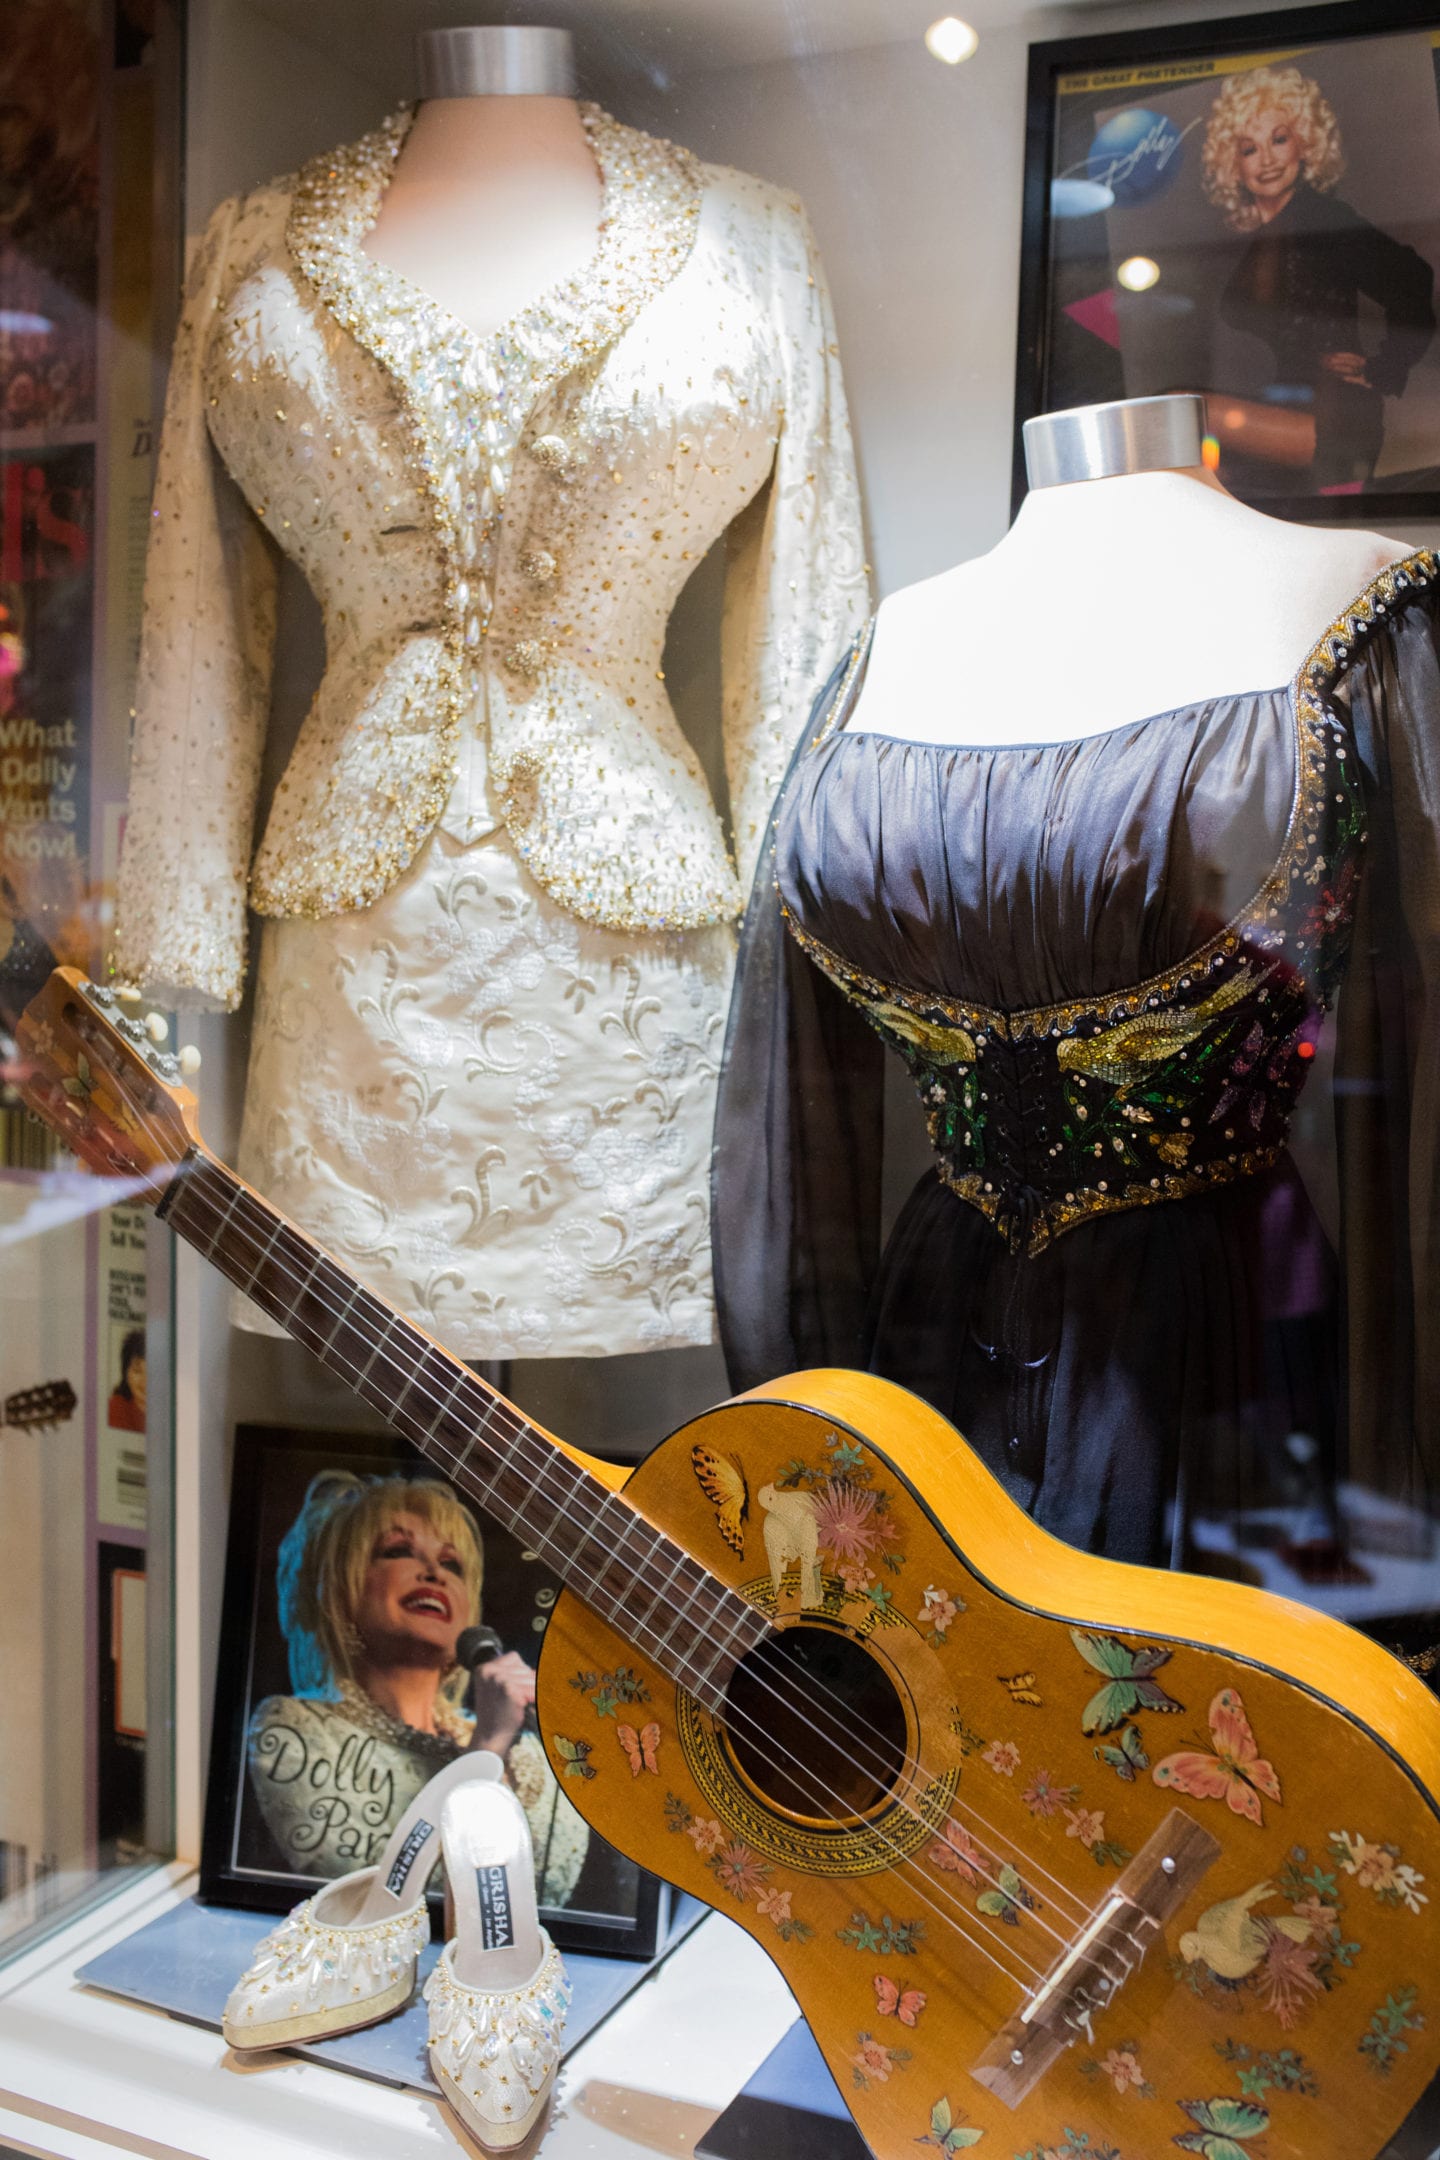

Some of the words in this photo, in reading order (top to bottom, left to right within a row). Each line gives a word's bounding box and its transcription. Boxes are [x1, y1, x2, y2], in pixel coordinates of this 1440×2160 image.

[1065, 78, 1088, 89] THE
[1092, 73, 1132, 86] GREAT
[1136, 61, 1215, 81] PRETENDER
[0, 718, 77, 748] What
[2, 755, 77, 793] Dolly
[257, 1724, 394, 1827] Dolly
[488, 1866, 509, 1948] GRISHA
